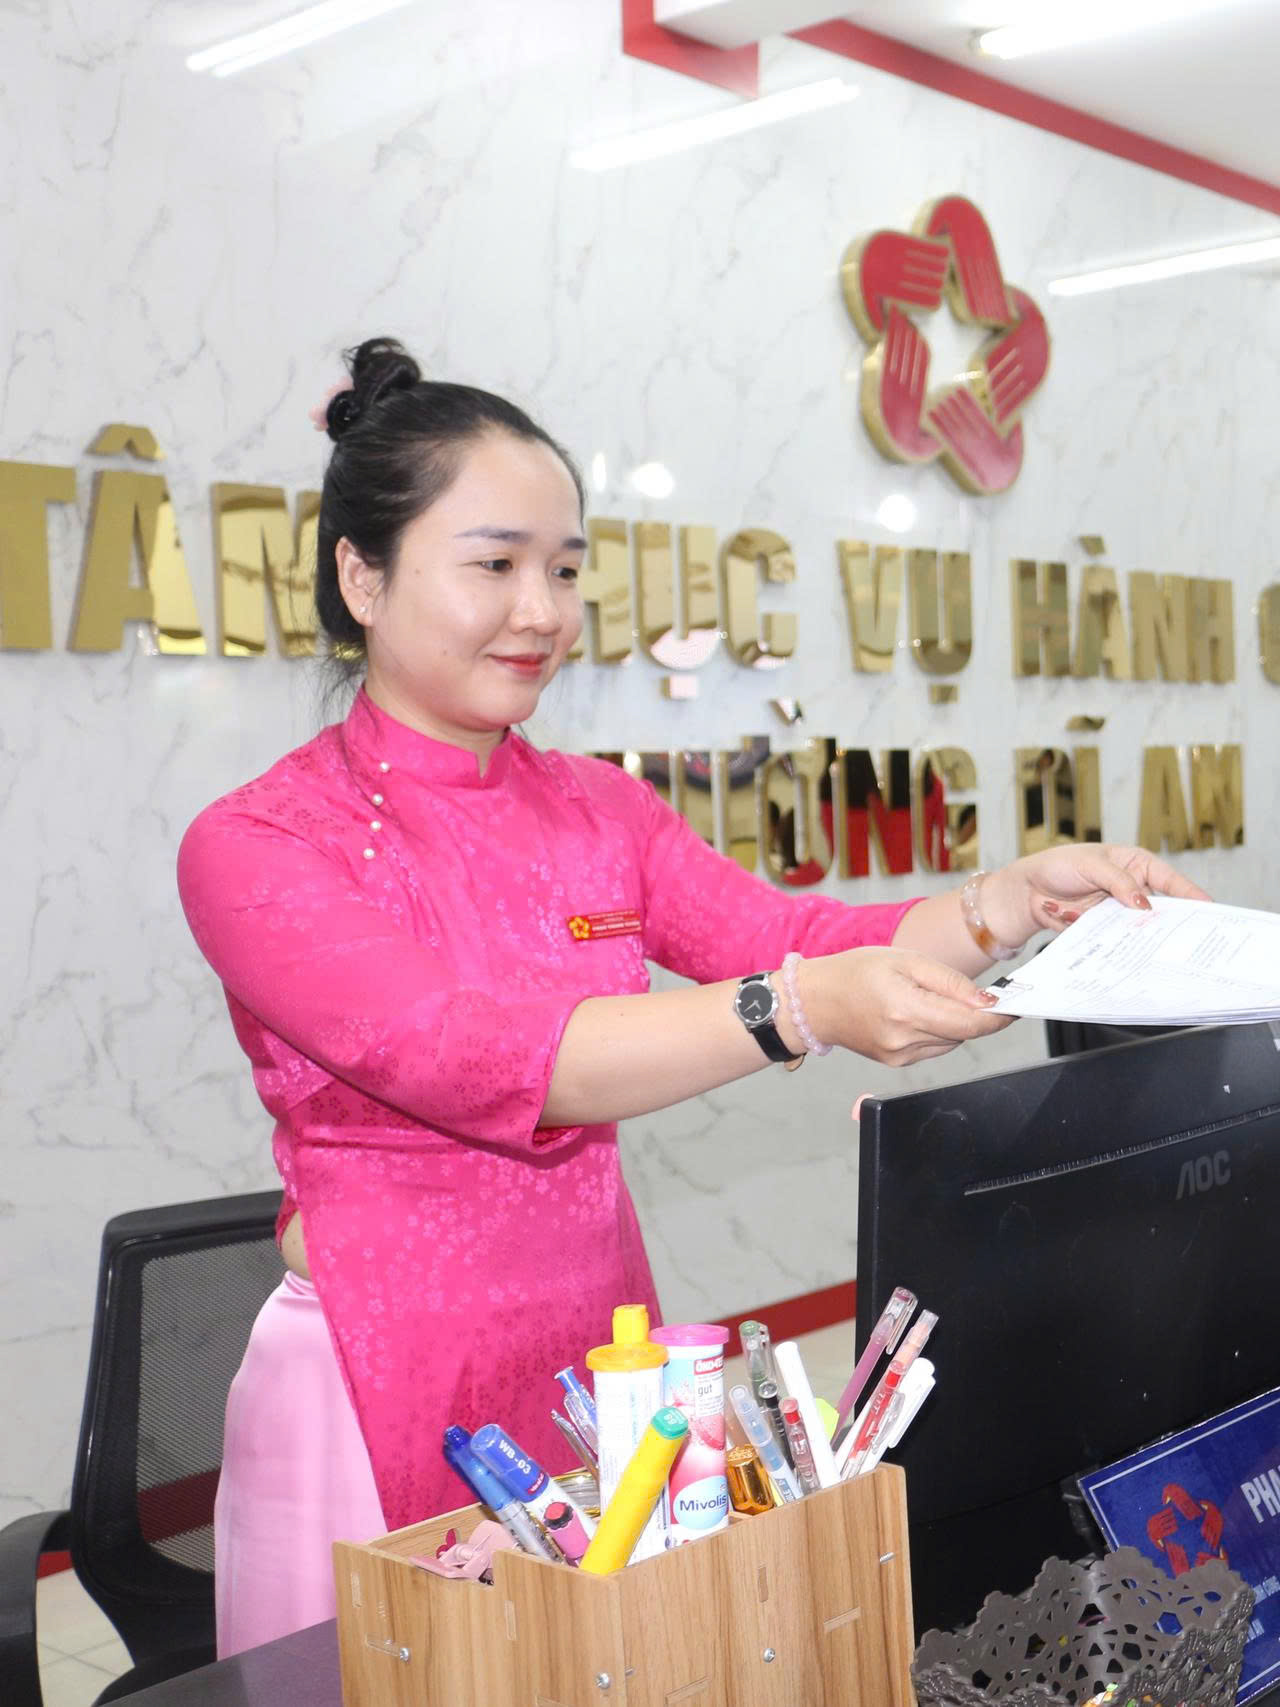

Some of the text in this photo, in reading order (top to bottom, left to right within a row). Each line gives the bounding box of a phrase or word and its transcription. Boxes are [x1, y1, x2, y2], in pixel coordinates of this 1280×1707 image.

[564, 517, 797, 699] HỤC
[837, 539, 972, 703] VỤ
[1009, 535, 1236, 685] HÀNH
[1137, 744, 1244, 855] AN
[1176, 1150, 1231, 1200] AOC
[698, 1384, 712, 1397] gut
[499, 1440, 531, 1474] WB-03
[679, 1493, 727, 1512] Mivolis
